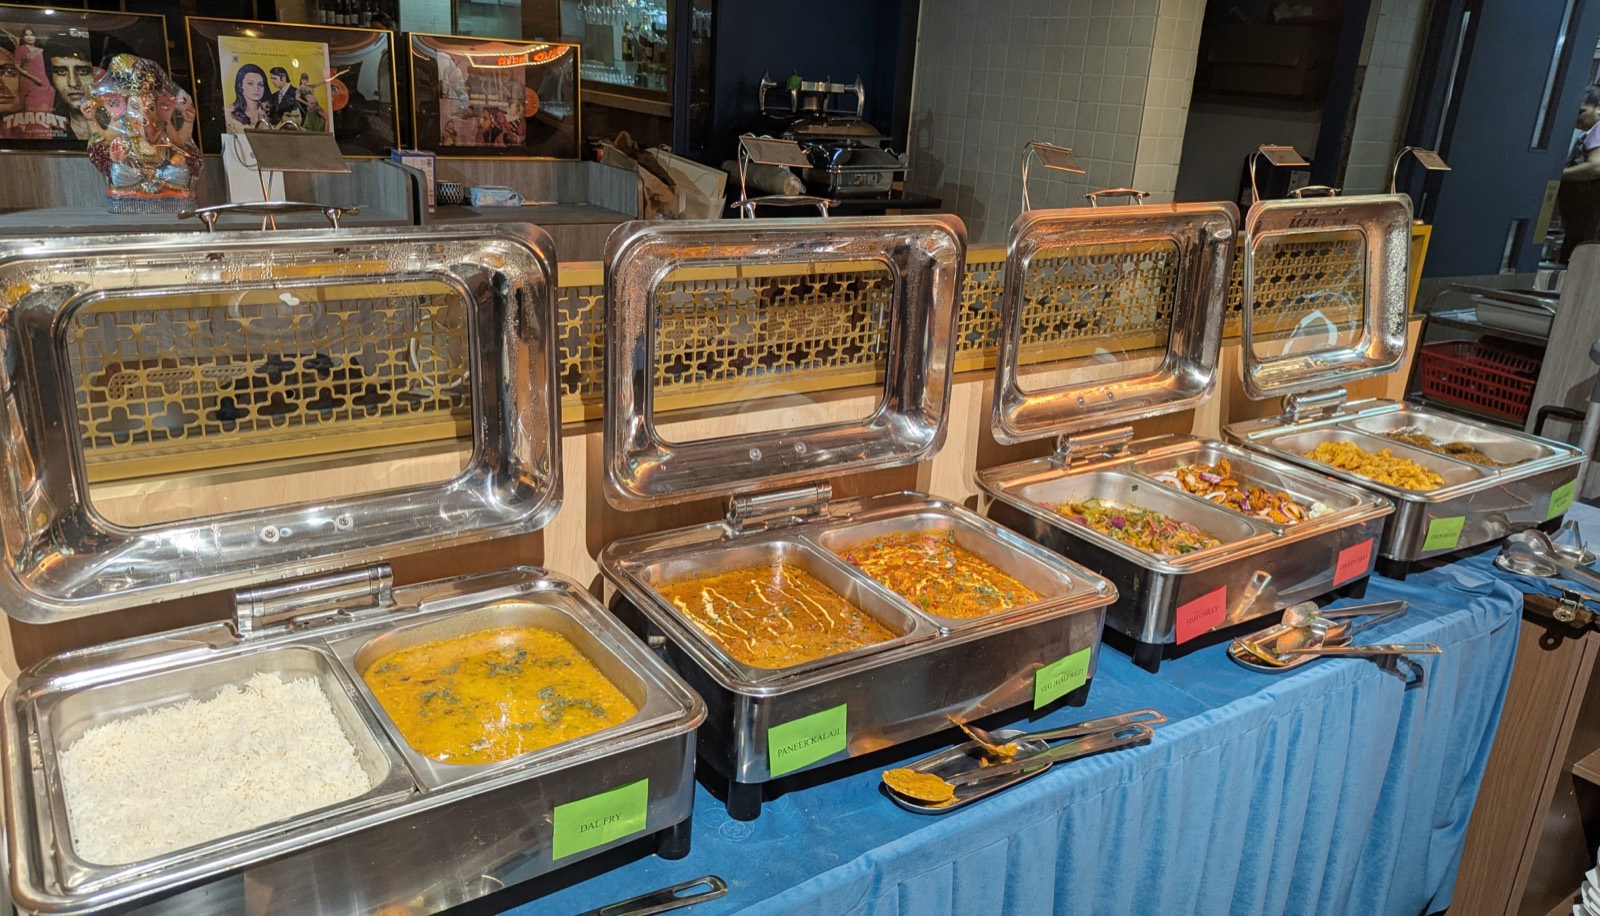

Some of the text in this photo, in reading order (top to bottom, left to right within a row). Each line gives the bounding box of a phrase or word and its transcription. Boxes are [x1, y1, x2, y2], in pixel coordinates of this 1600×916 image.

[3, 112, 69, 129] TAAQAT
[1040, 681, 1053, 692] VEG
[777, 728, 841, 757] PANEER KALAJI
[580, 812, 623, 833] DAL FRY
